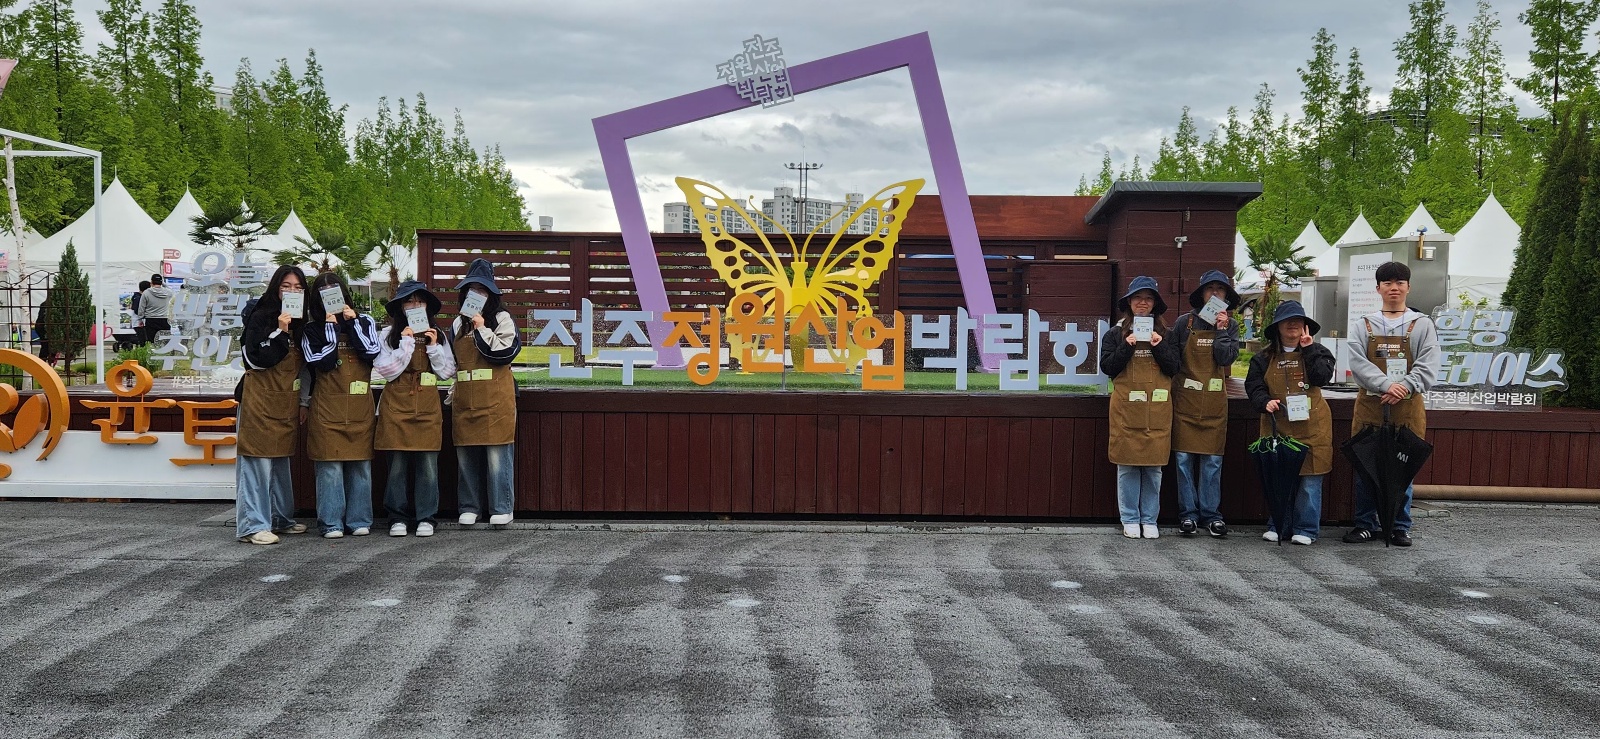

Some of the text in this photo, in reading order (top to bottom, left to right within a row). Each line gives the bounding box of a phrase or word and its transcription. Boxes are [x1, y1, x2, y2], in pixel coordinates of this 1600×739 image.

[745, 36, 782, 62] 전주
[738, 77, 793, 106] 박람회
[185, 252, 268, 288] 오늘
[1436, 308, 1514, 347] 힐링
[171, 375, 239, 389] #전주정원
